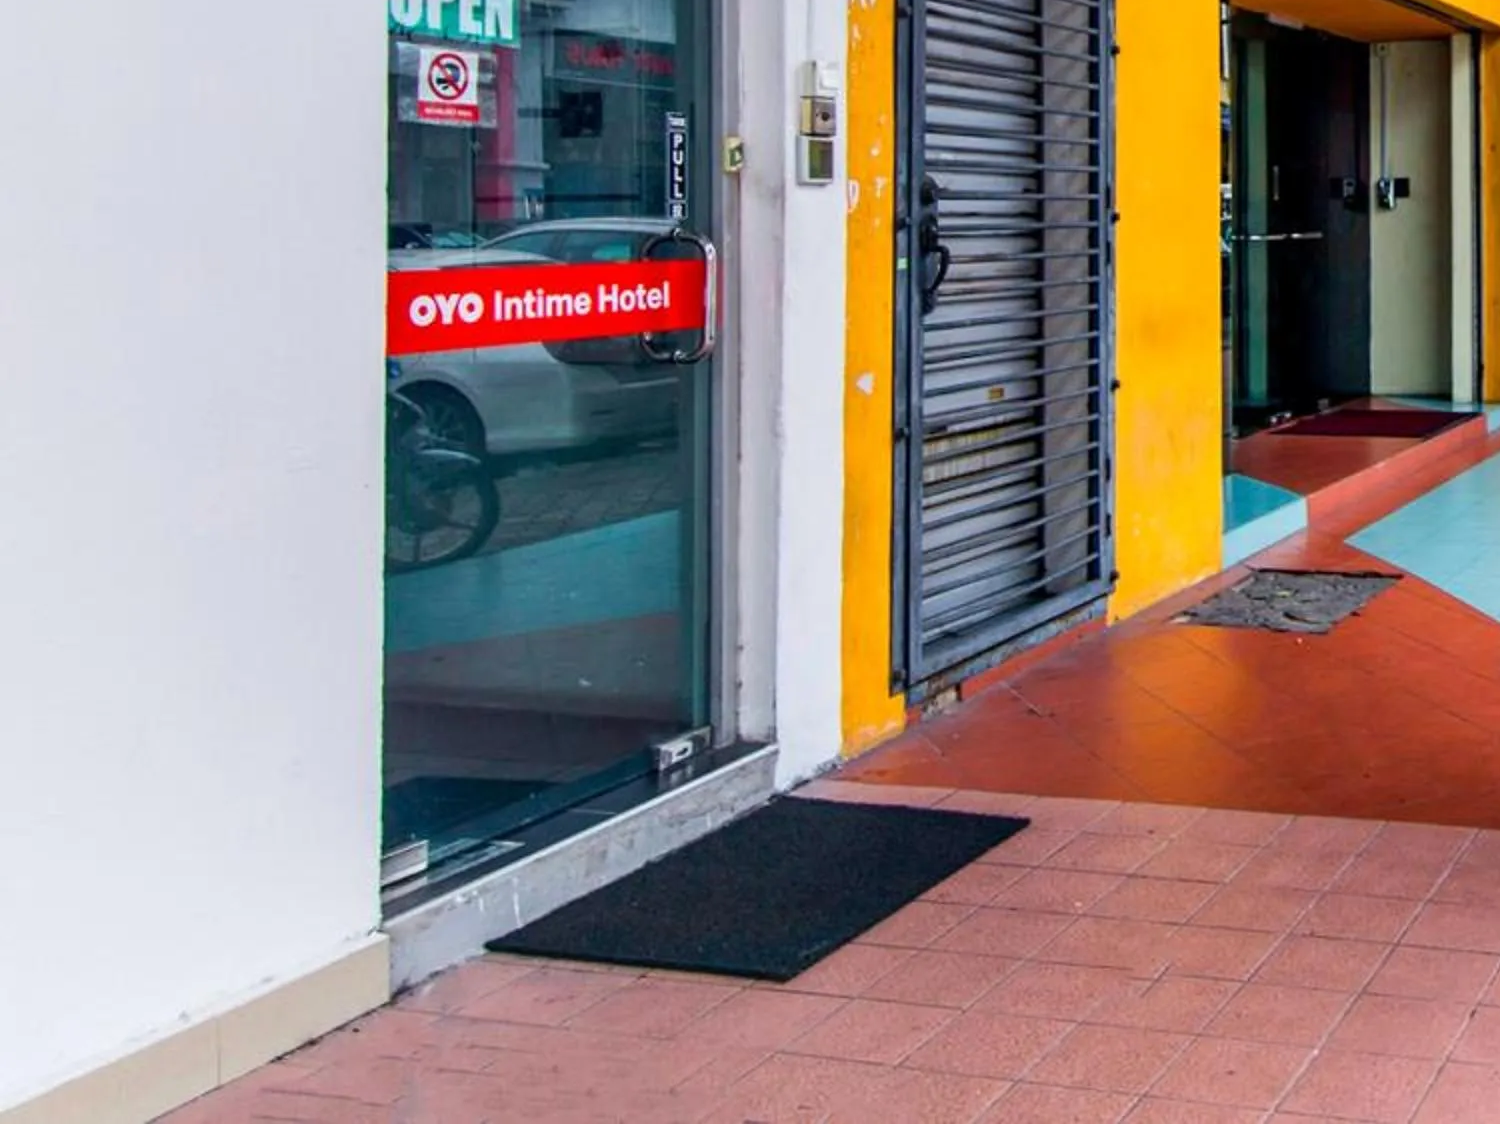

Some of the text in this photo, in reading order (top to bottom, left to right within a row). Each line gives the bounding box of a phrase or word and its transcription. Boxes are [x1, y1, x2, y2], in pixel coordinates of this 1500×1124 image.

[672, 133, 683, 199] PULL
[409, 280, 671, 327] OYO Intime Hotel
